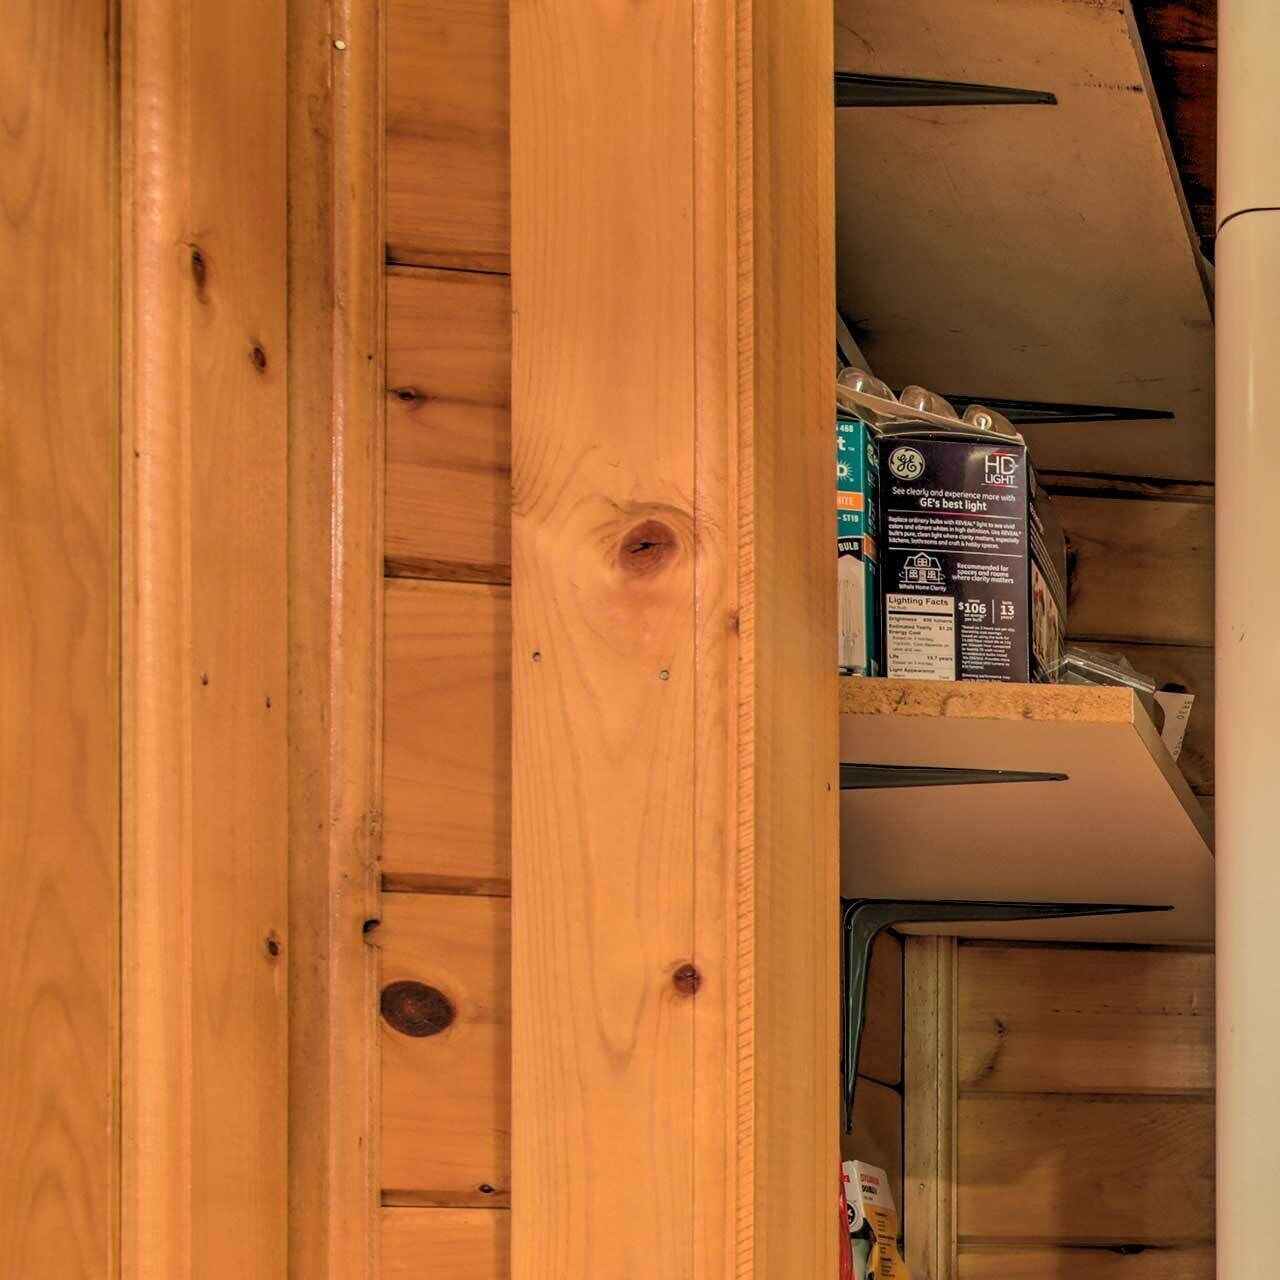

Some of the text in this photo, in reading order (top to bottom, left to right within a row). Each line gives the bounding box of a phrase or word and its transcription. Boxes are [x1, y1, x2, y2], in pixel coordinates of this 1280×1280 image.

[984, 455, 1016, 475] HD
[985, 474, 1016, 485] LIGHT
[892, 486, 1016, 502] See clearly and experience more with
[920, 498, 987, 512] GE's best light
[838, 541, 859, 551] BULB
[957, 562, 999, 571] Recommended
[952, 574, 1014, 584] where clarity matters
[888, 596, 949, 606] Lighting Facts
[958, 601, 987, 614] $106
[1000, 605, 1015, 616] 13
